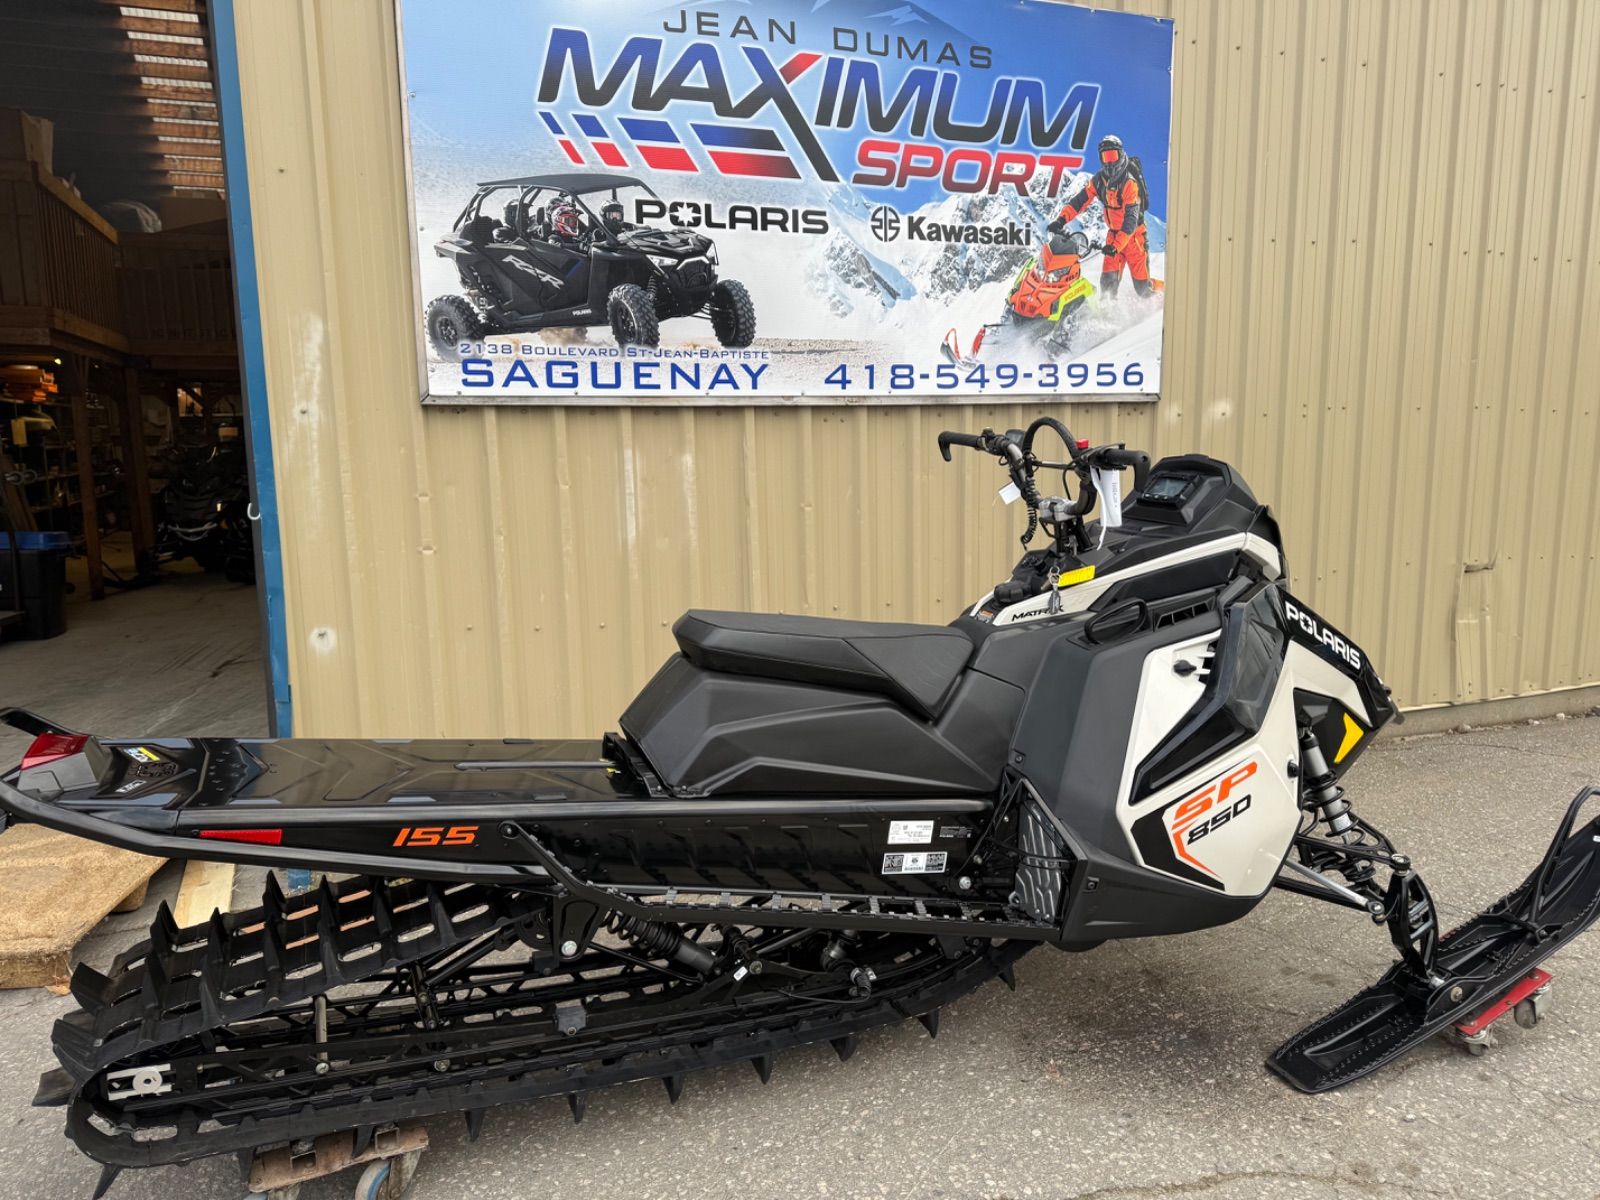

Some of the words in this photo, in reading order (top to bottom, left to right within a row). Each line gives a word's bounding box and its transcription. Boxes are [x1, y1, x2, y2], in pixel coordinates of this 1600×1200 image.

[663, 9, 796, 45] JEAN
[832, 26, 993, 69] DUMAS
[537, 27, 1101, 183] MAXIMUM
[852, 139, 1083, 198] SPORT
[634, 199, 829, 234] POLARIS
[907, 215, 1031, 246] Kawasaki
[460, 343, 512, 355] 2138
[461, 358, 769, 391] SAGUENAY
[824, 362, 1144, 391] 418-549-3956
[1285, 601, 1361, 670] POLARIS
[1171, 761, 1258, 831] SP
[392, 825, 480, 847] 155
[1187, 794, 1252, 846] 850
